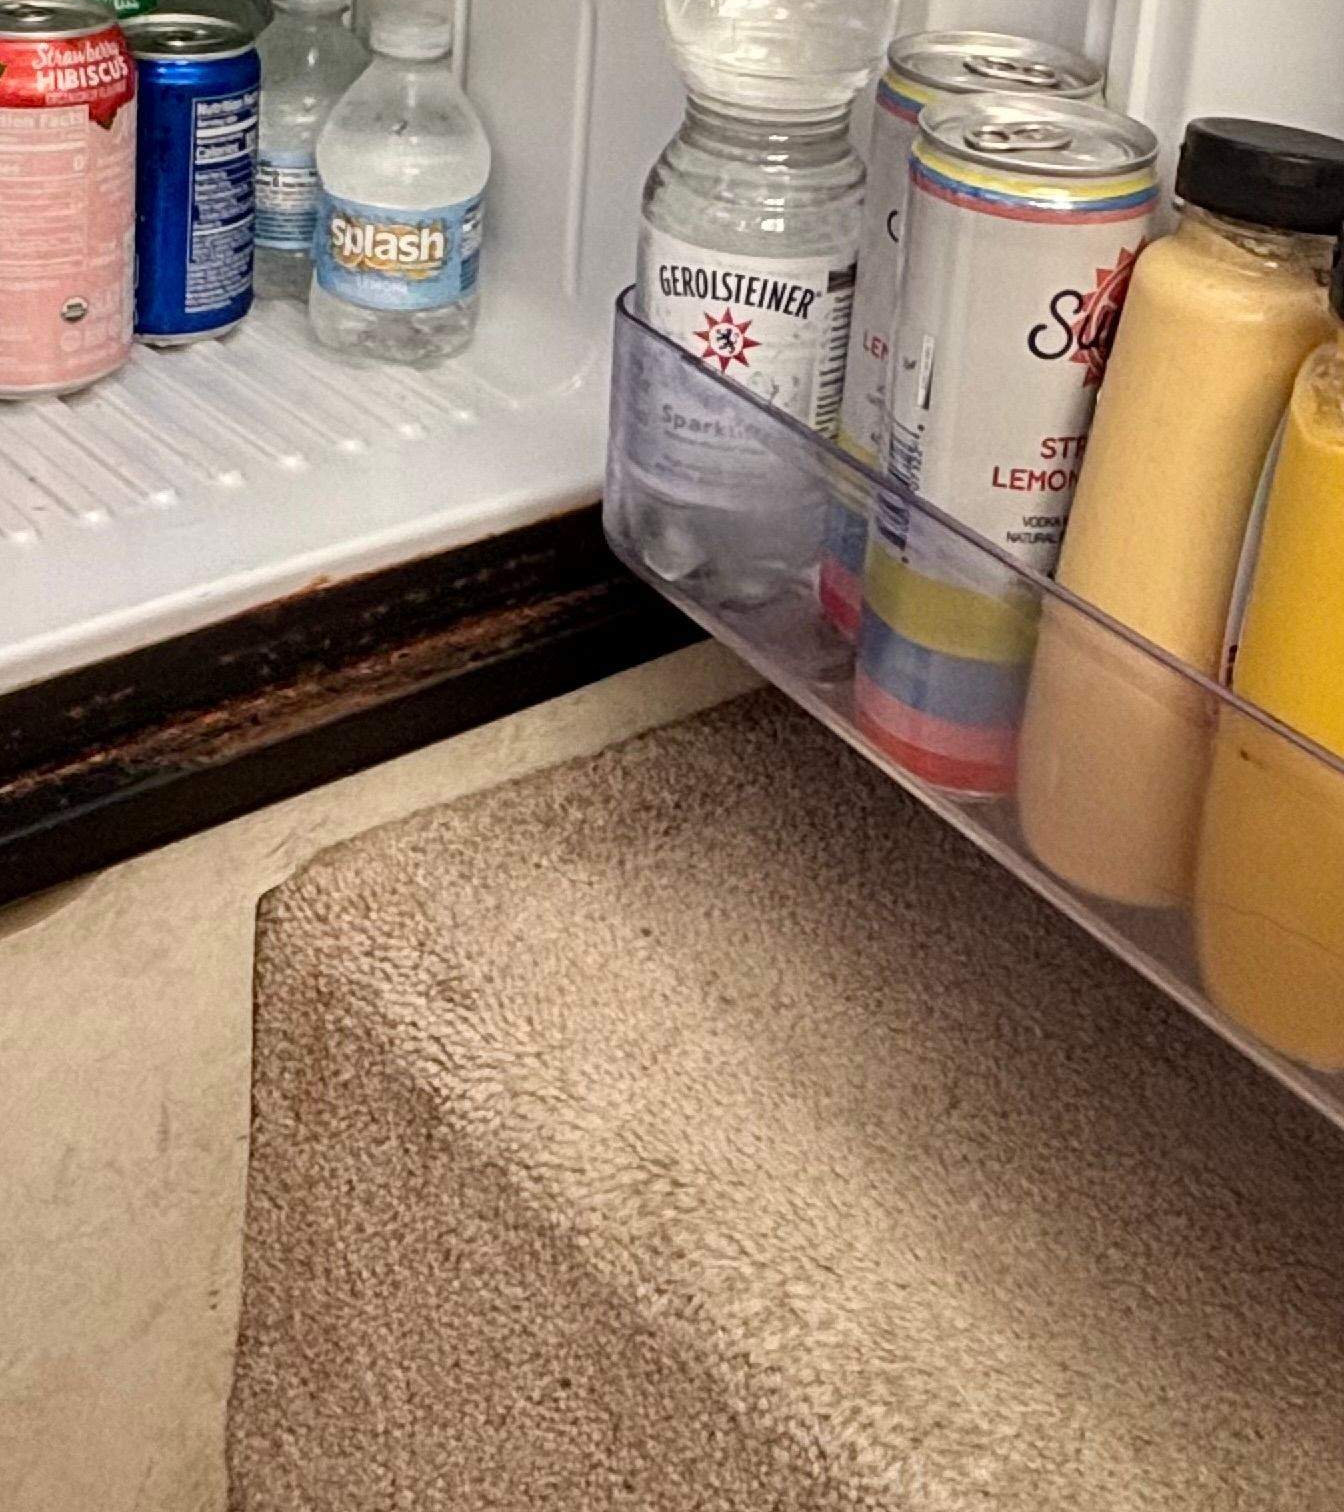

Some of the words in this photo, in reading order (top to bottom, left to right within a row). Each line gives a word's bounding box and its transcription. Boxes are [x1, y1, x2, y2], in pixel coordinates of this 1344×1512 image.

[36, 56, 129, 92] HIBISCUS
[658, 263, 816, 321] GEROLSTEINER
[992, 464, 1079, 492] LEMON
